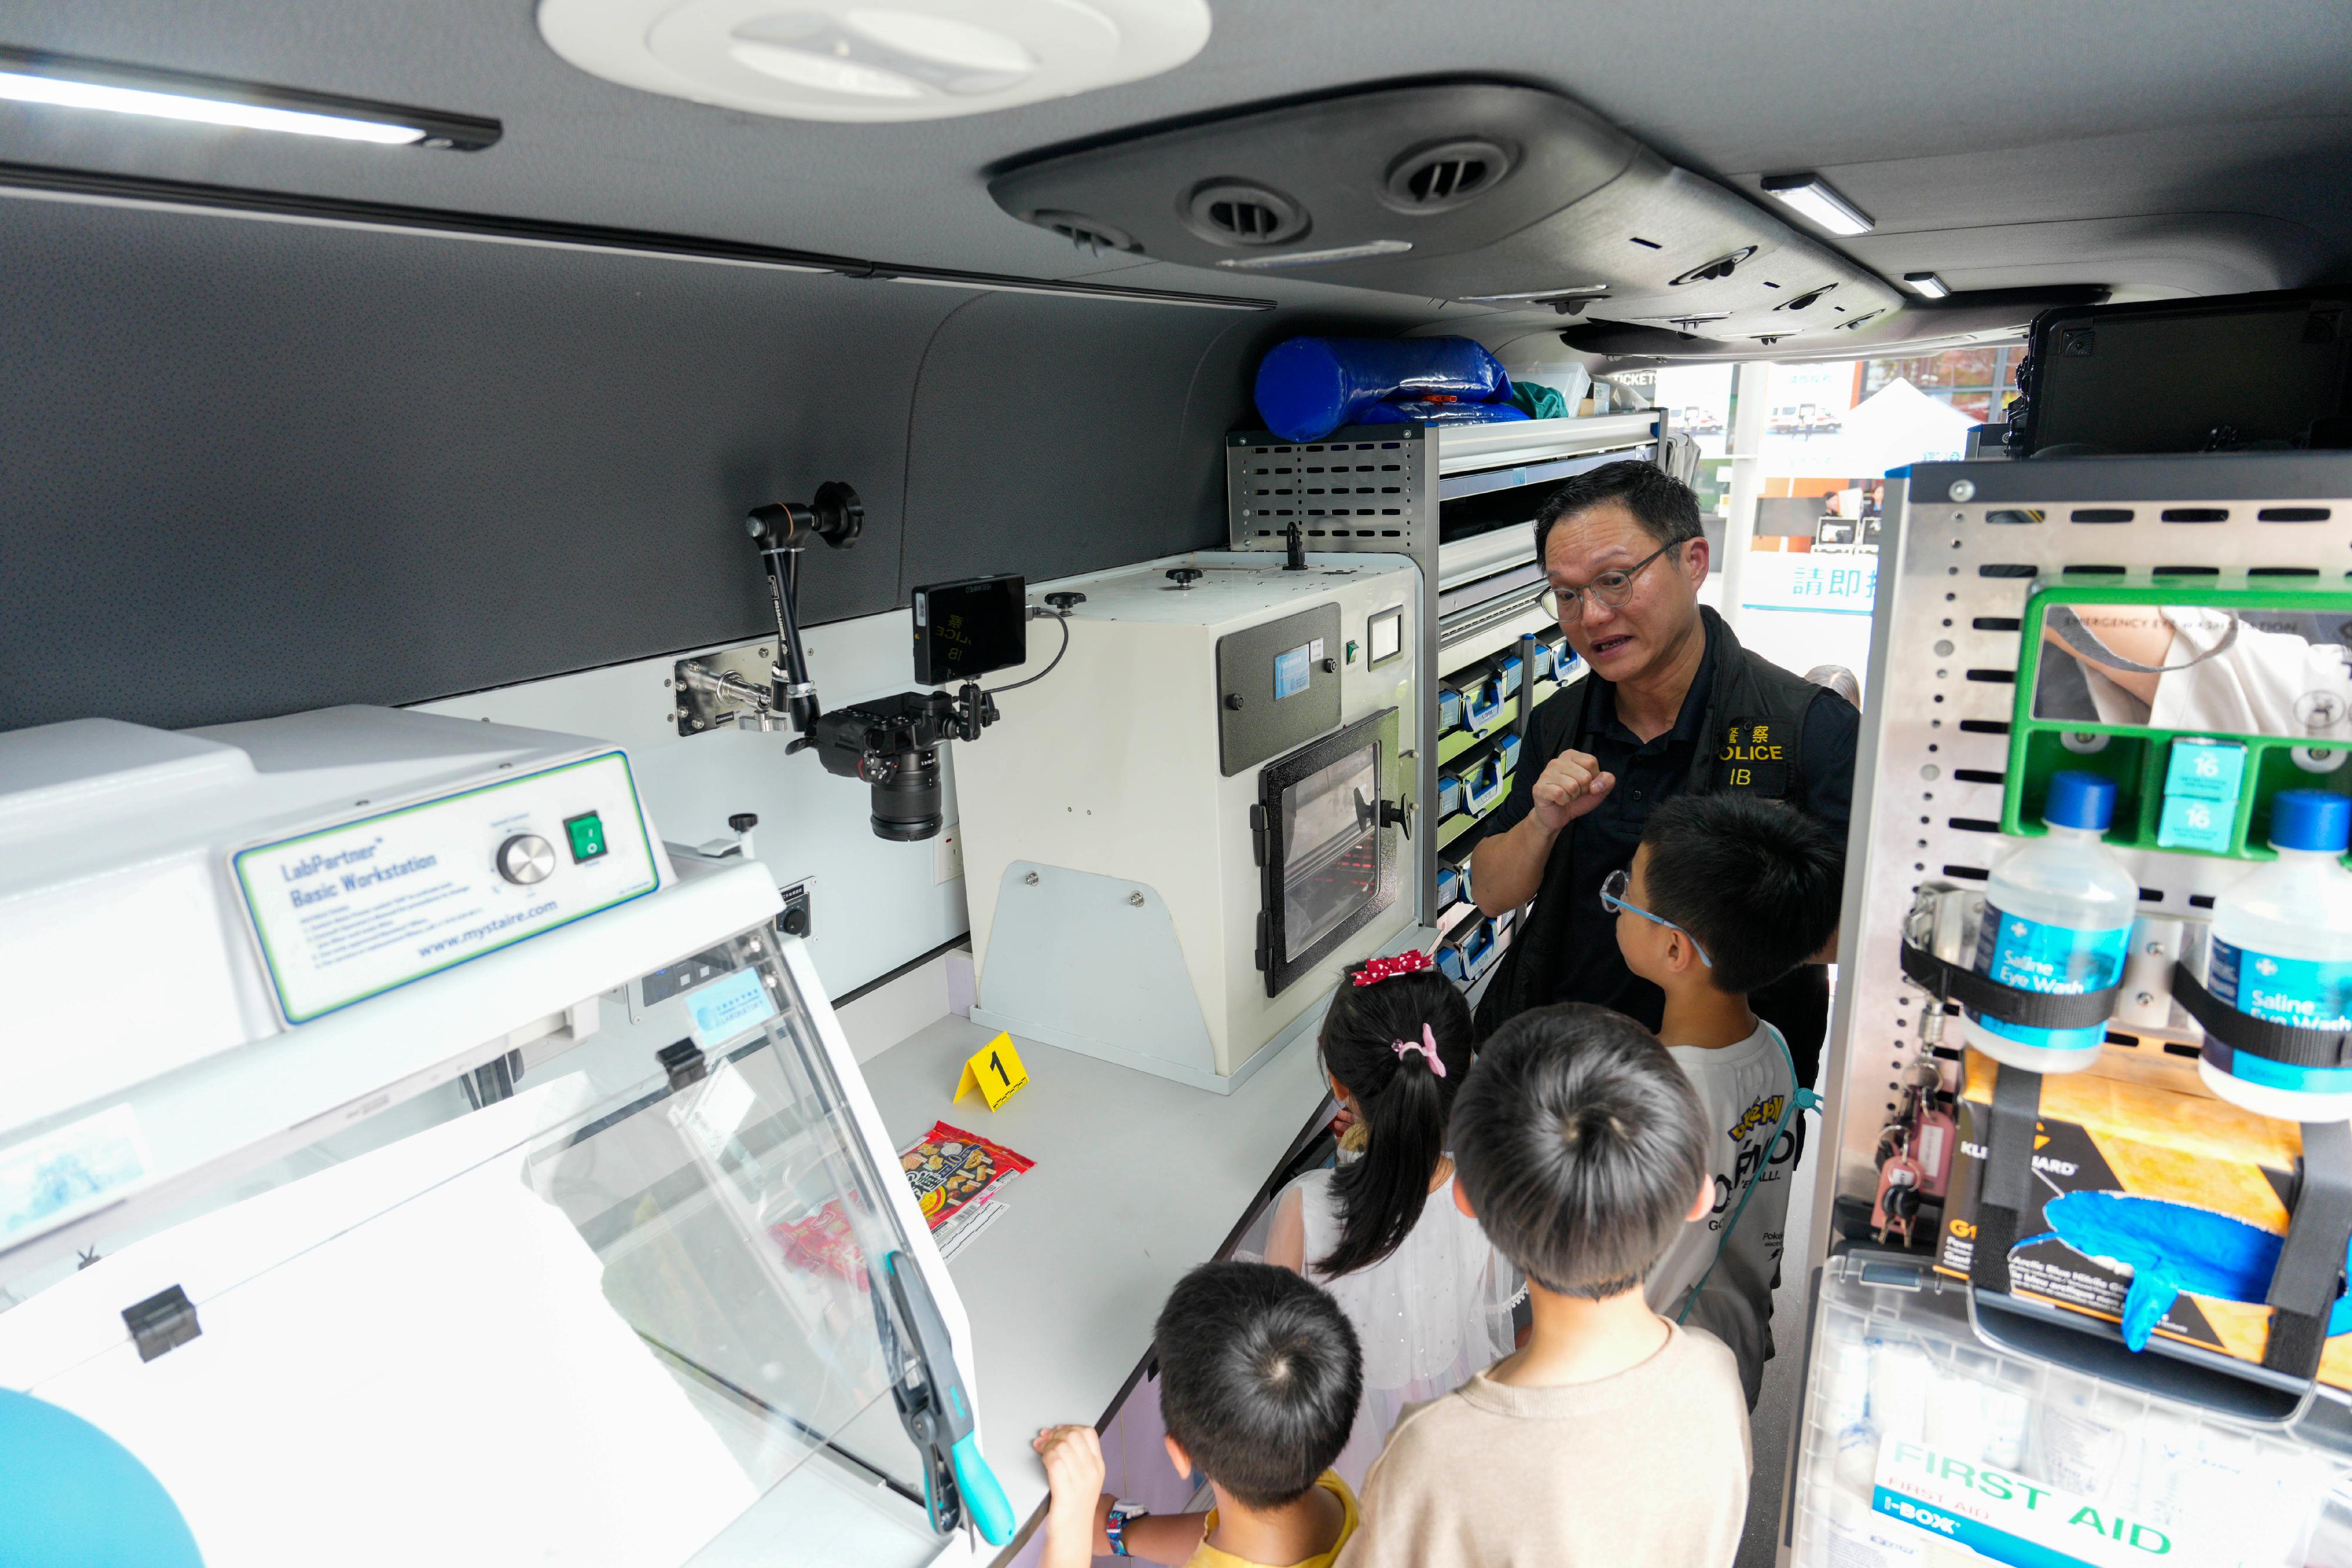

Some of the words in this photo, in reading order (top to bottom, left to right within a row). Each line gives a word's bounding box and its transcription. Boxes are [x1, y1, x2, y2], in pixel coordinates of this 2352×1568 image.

[1719, 745, 1783, 761] OLICE
[1730, 768, 1751, 785] IB
[2193, 757, 2220, 778] 16
[2184, 807, 2211, 830] 16
[290, 884, 339, 909] Basic
[340, 854, 437, 892] Workstation
[417, 900, 558, 957] www.mystaire.com
[2003, 949, 2054, 977] Saline
[2000, 965, 2029, 988] Eye
[2032, 975, 2084, 995] Wash
[2252, 989, 2315, 1017] Saline
[990, 1051, 1011, 1087] 1
[2045, 1264, 2072, 1279] Blue
[1889, 1476, 1945, 1503] FIRST
[1954, 1499, 1989, 1520] AID
[1893, 1440, 2051, 1511] FIRST
[2067, 1505, 2172, 1555] AID
